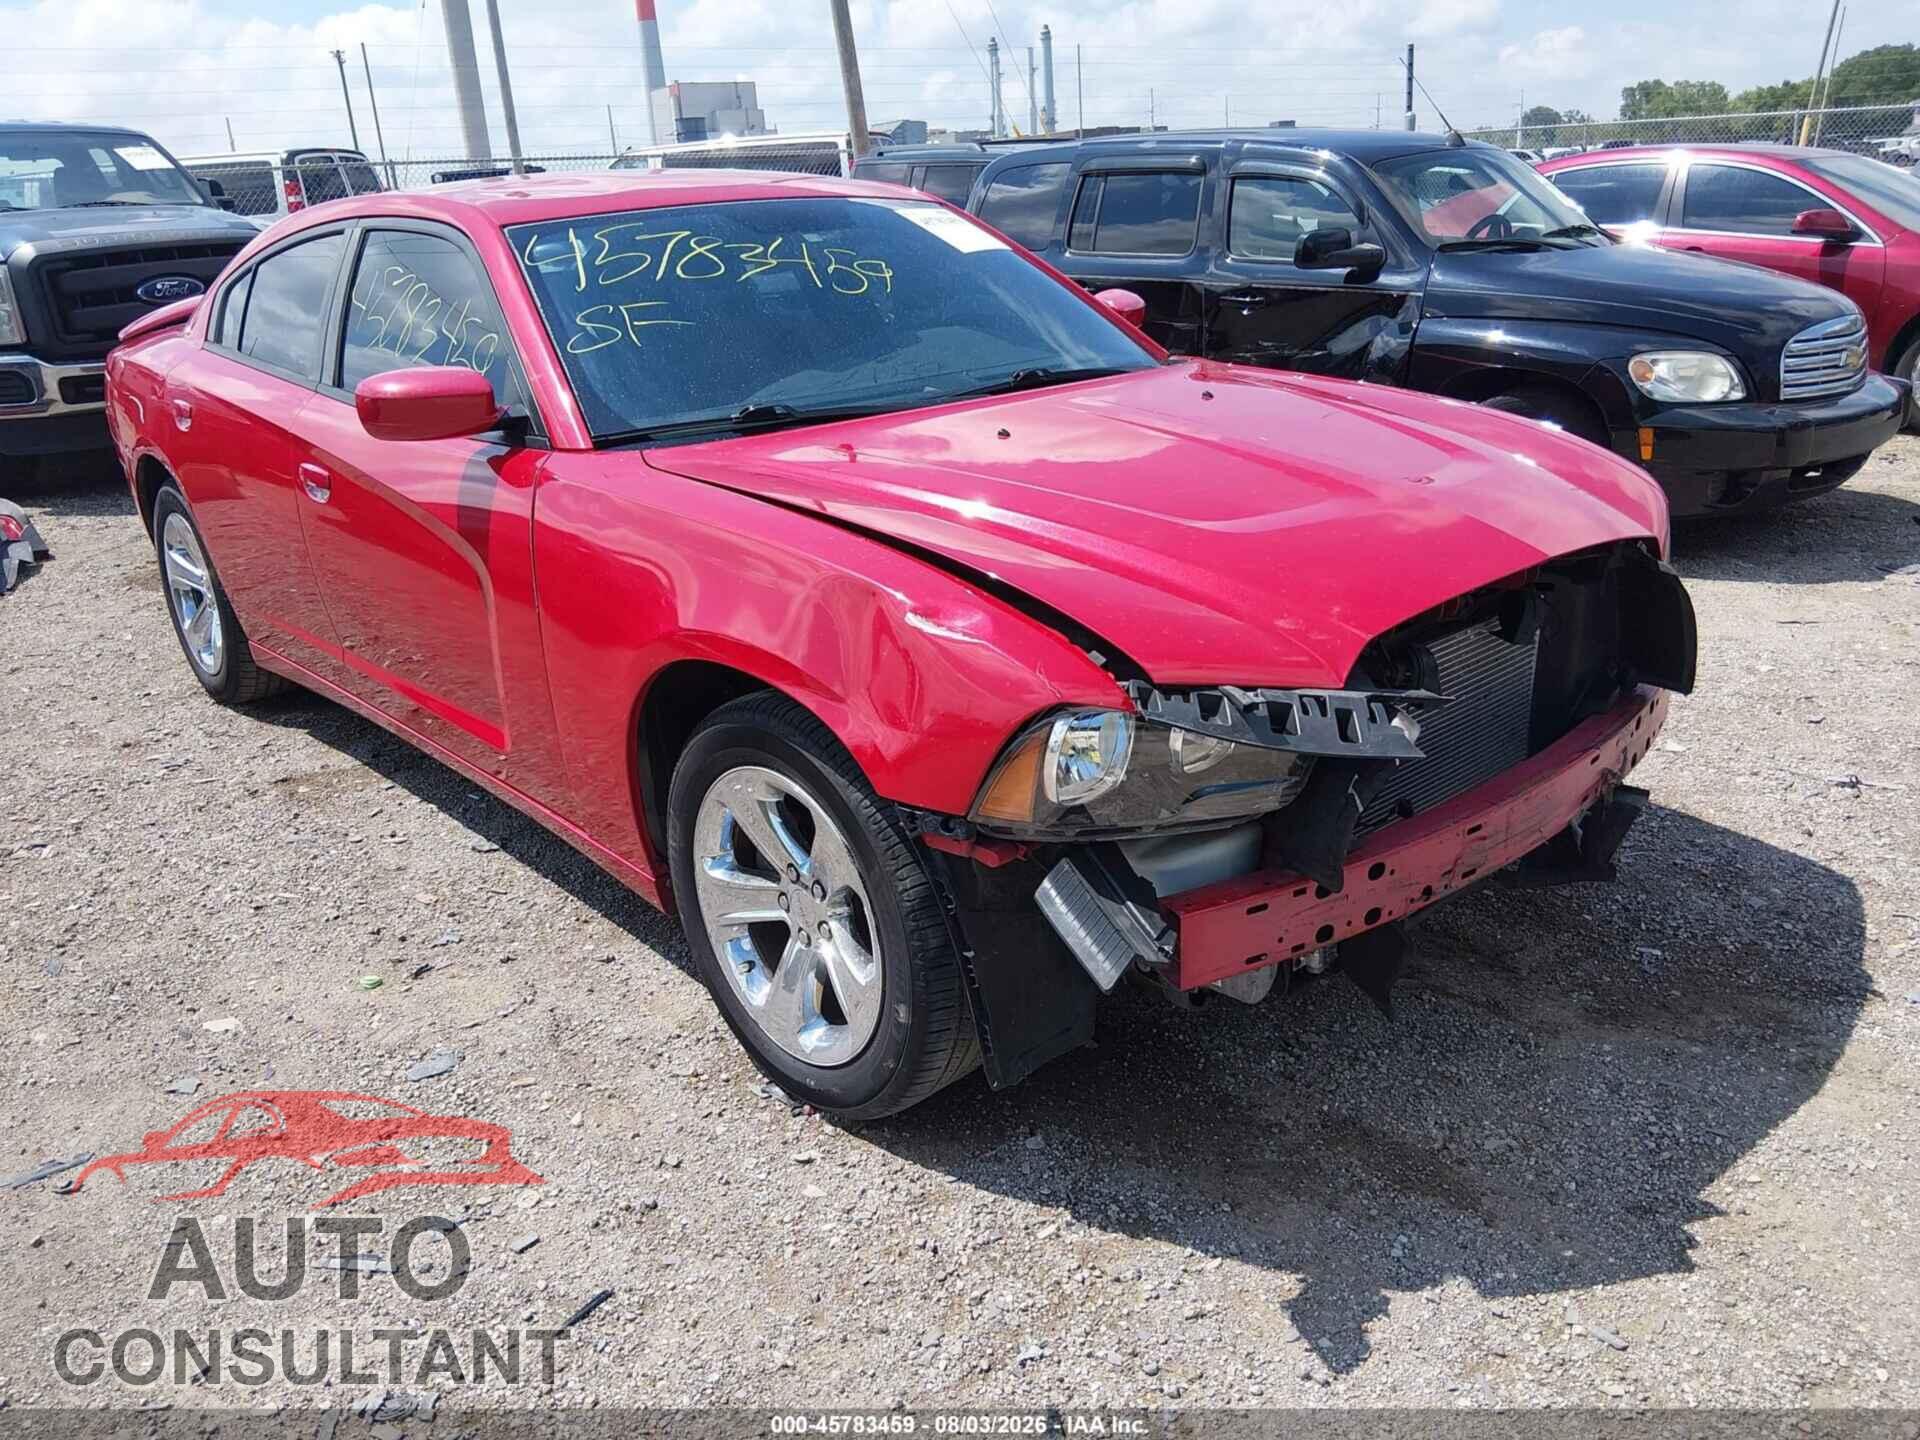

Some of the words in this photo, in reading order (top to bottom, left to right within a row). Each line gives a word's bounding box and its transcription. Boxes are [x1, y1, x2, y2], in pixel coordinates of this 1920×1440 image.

[525, 222, 895, 295] 45783459
[154, 280, 190, 297] Ford
[566, 300, 696, 354] SF
